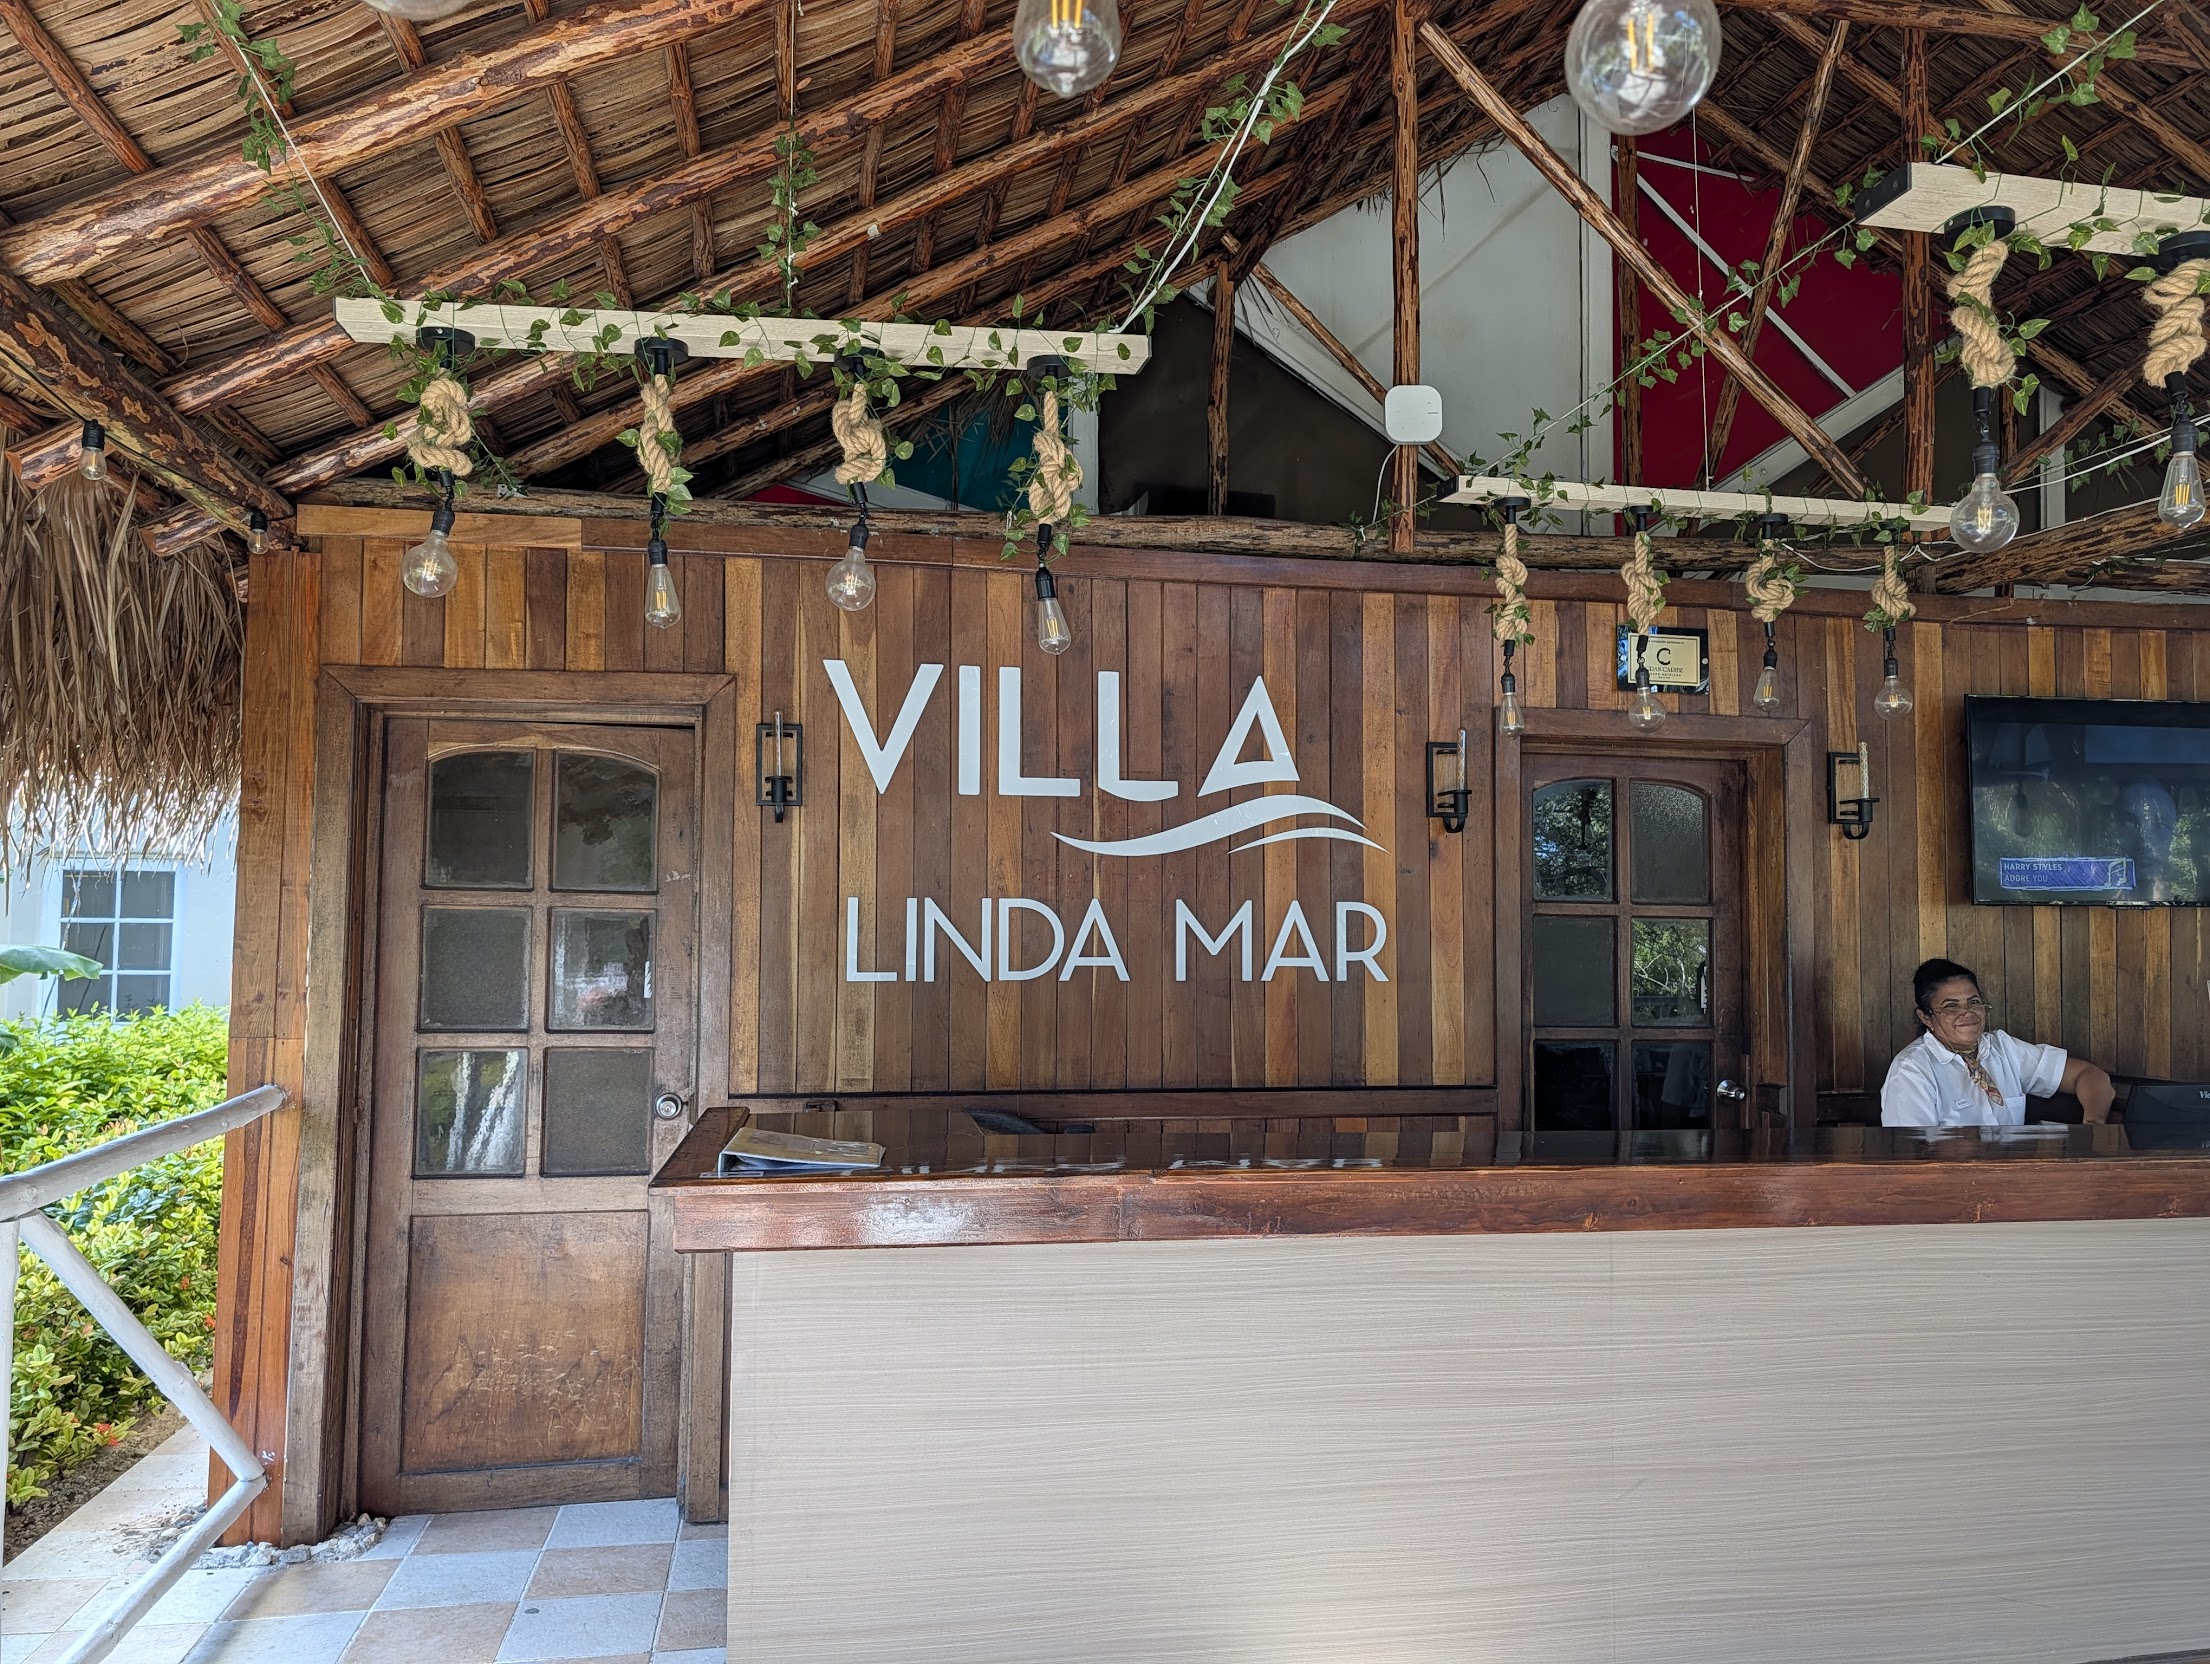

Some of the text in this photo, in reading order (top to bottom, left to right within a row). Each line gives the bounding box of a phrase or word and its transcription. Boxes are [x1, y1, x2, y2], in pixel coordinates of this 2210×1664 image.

[822, 659, 1300, 802] VILLA
[2004, 863, 2063, 871] HARRY STYLES
[2032, 874, 2048, 882] YOU
[846, 897, 1390, 983] LINDA MAR
